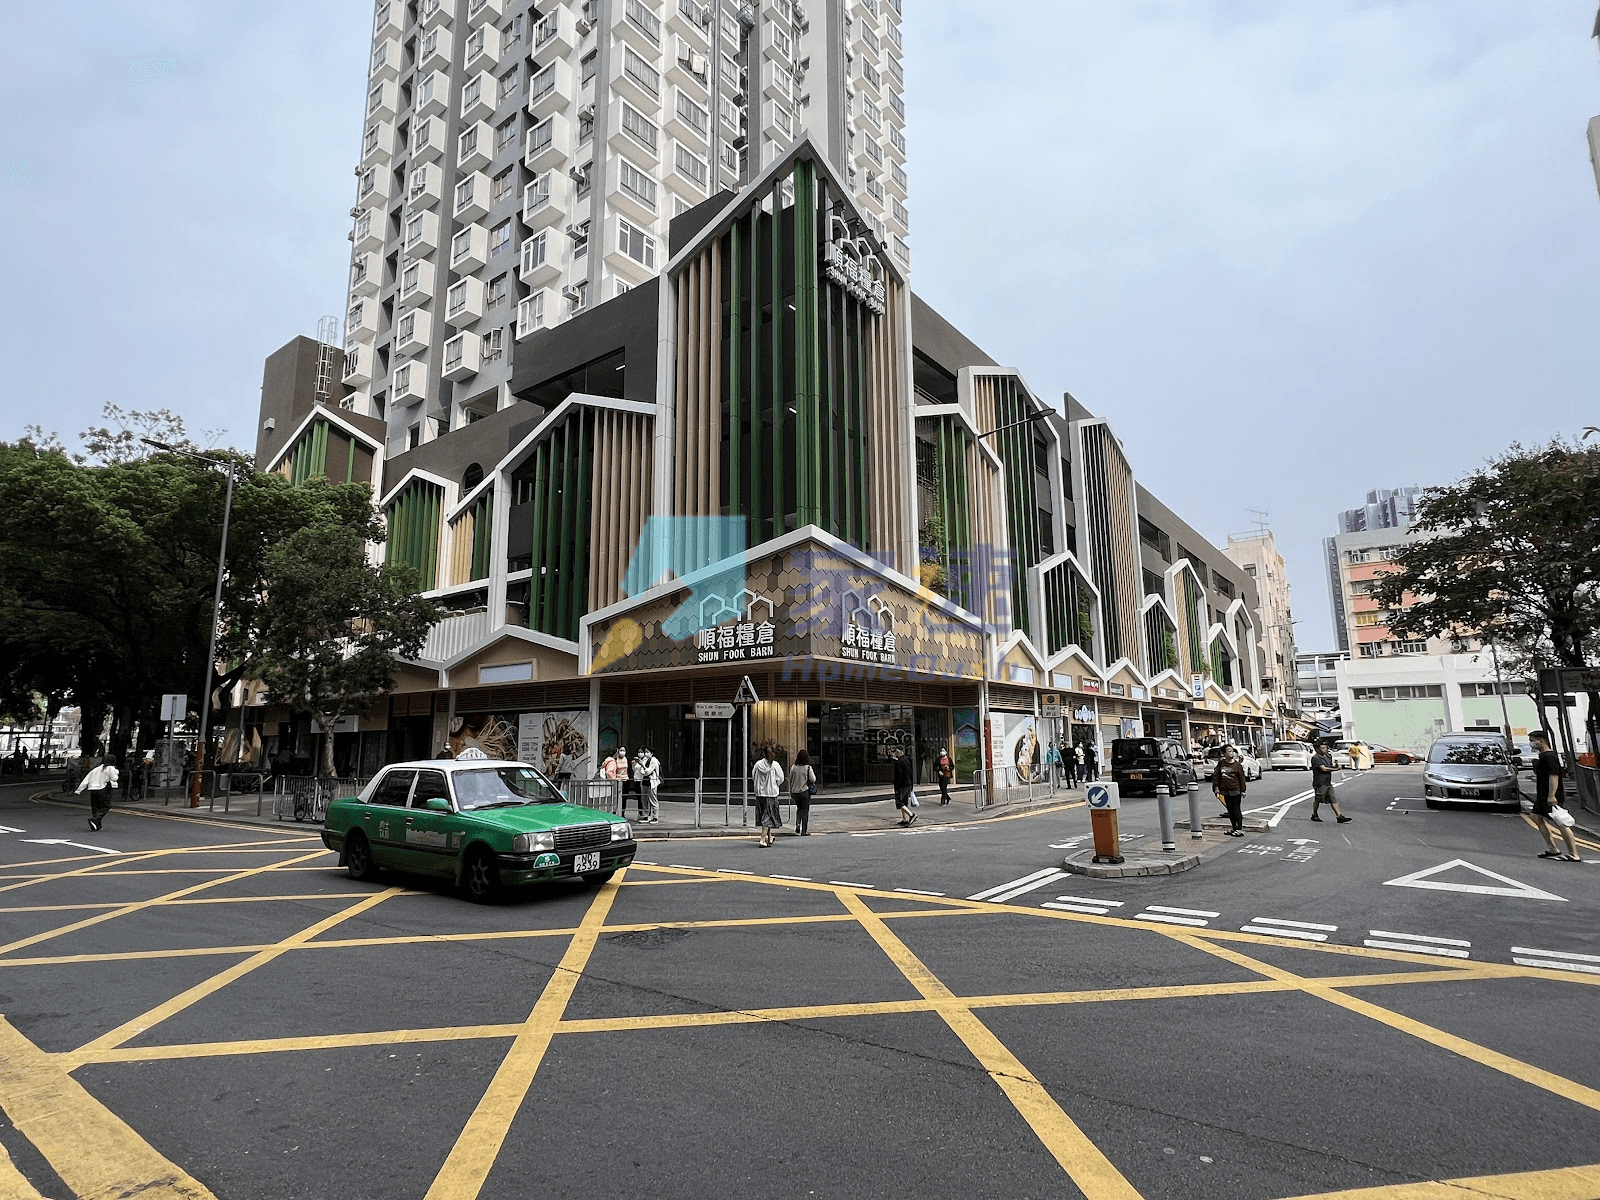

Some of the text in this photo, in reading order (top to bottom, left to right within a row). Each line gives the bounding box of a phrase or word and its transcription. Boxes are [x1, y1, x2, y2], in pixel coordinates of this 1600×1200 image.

[698, 620, 775, 650] 順福糧倉
[841, 622, 896, 652] 順福糧倉
[698, 646, 774, 662] SHUN FOOK BARN
[841, 646, 896, 664] SHUN FOOK BARN
[576, 860, 598, 872] 2539
[581, 853, 593, 863] ND
